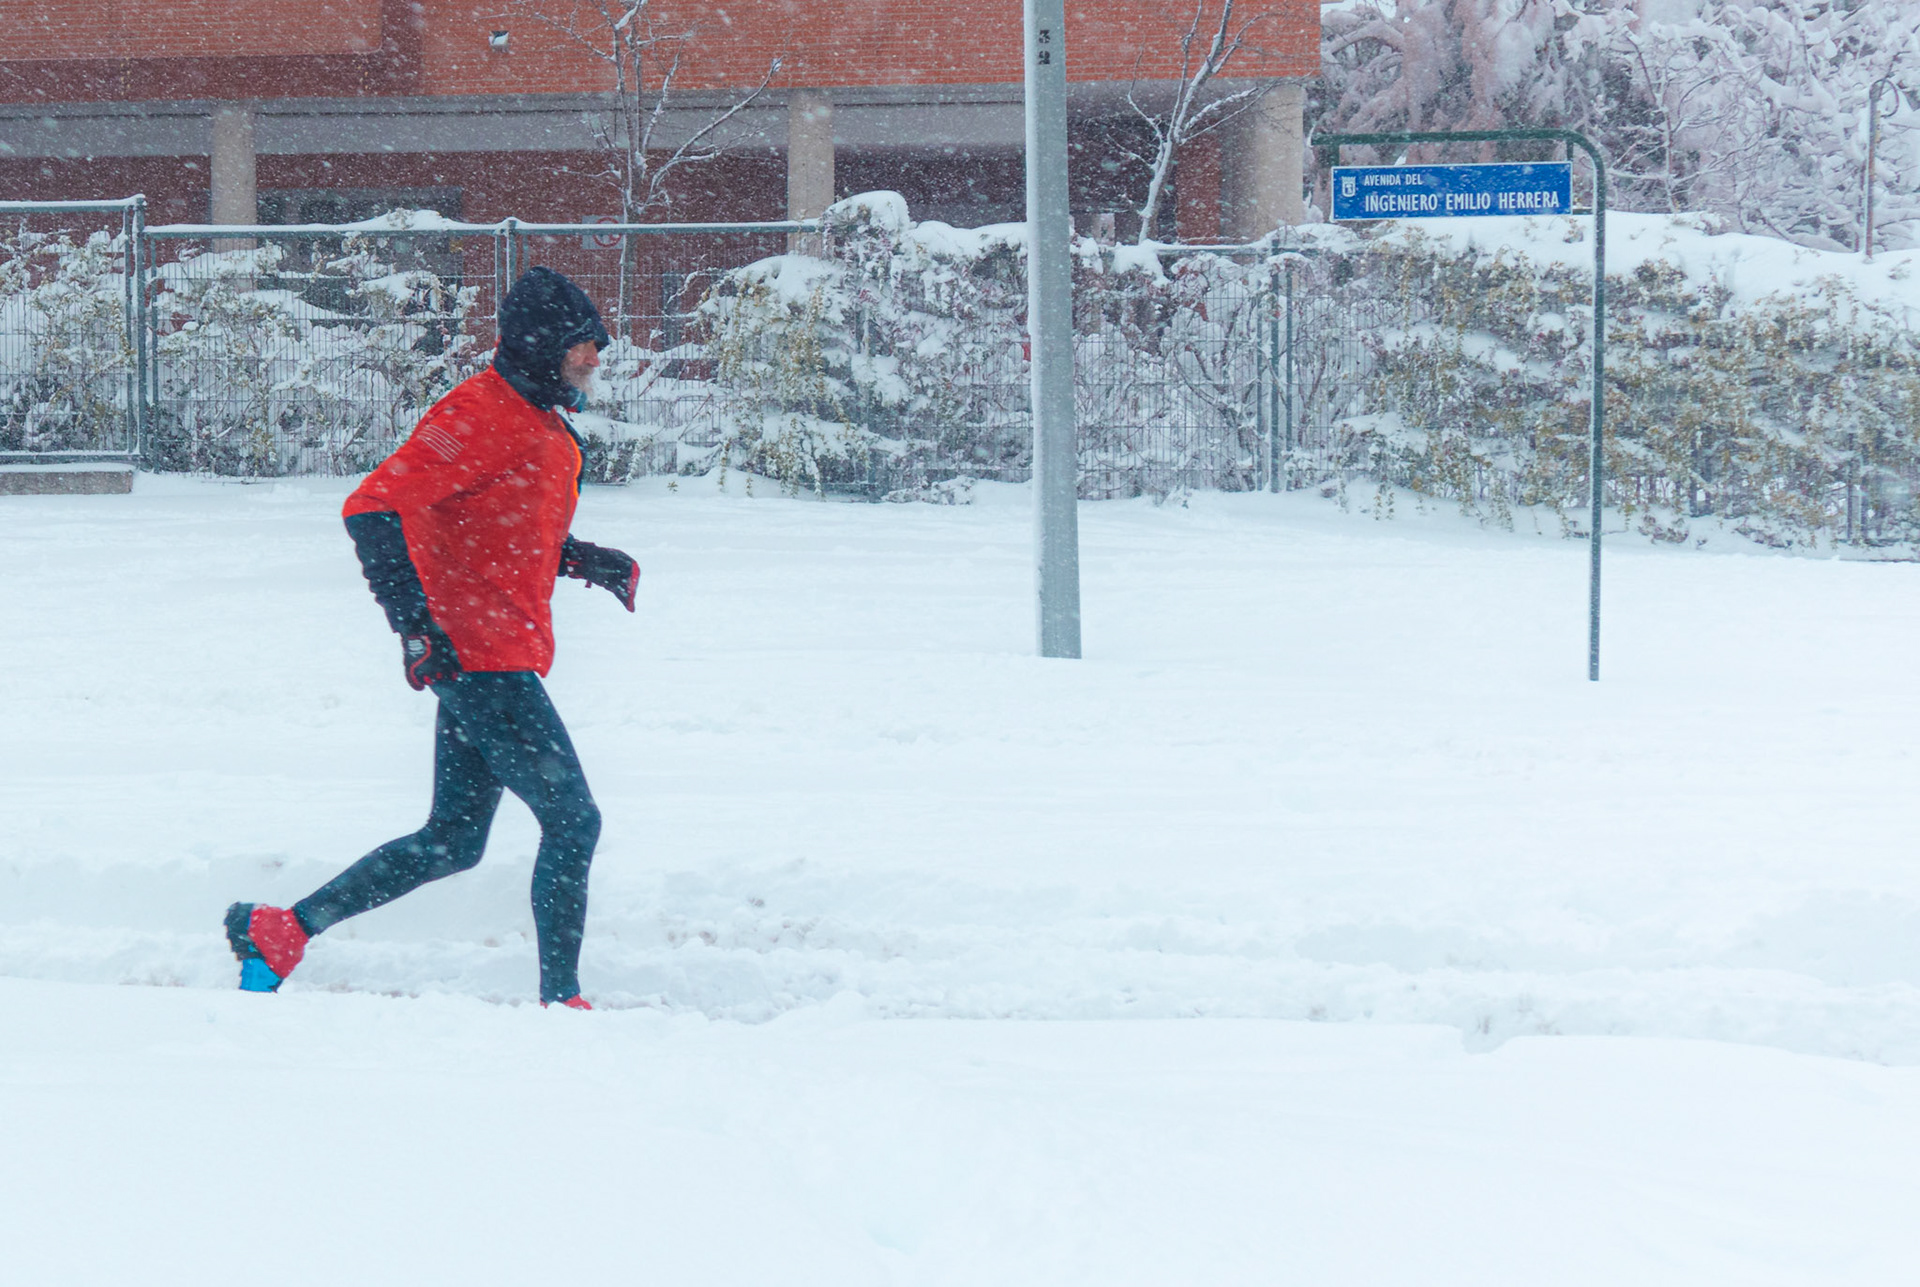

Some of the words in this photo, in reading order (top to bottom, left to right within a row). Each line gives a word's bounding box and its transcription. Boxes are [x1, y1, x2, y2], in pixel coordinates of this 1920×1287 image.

[1363, 174, 1401, 187] AVENIDA
[1405, 173, 1424, 186] DEL
[1364, 193, 1438, 212] INGENIERO
[1445, 192, 1491, 210] EMILIO
[1498, 190, 1560, 209] HERRERA
